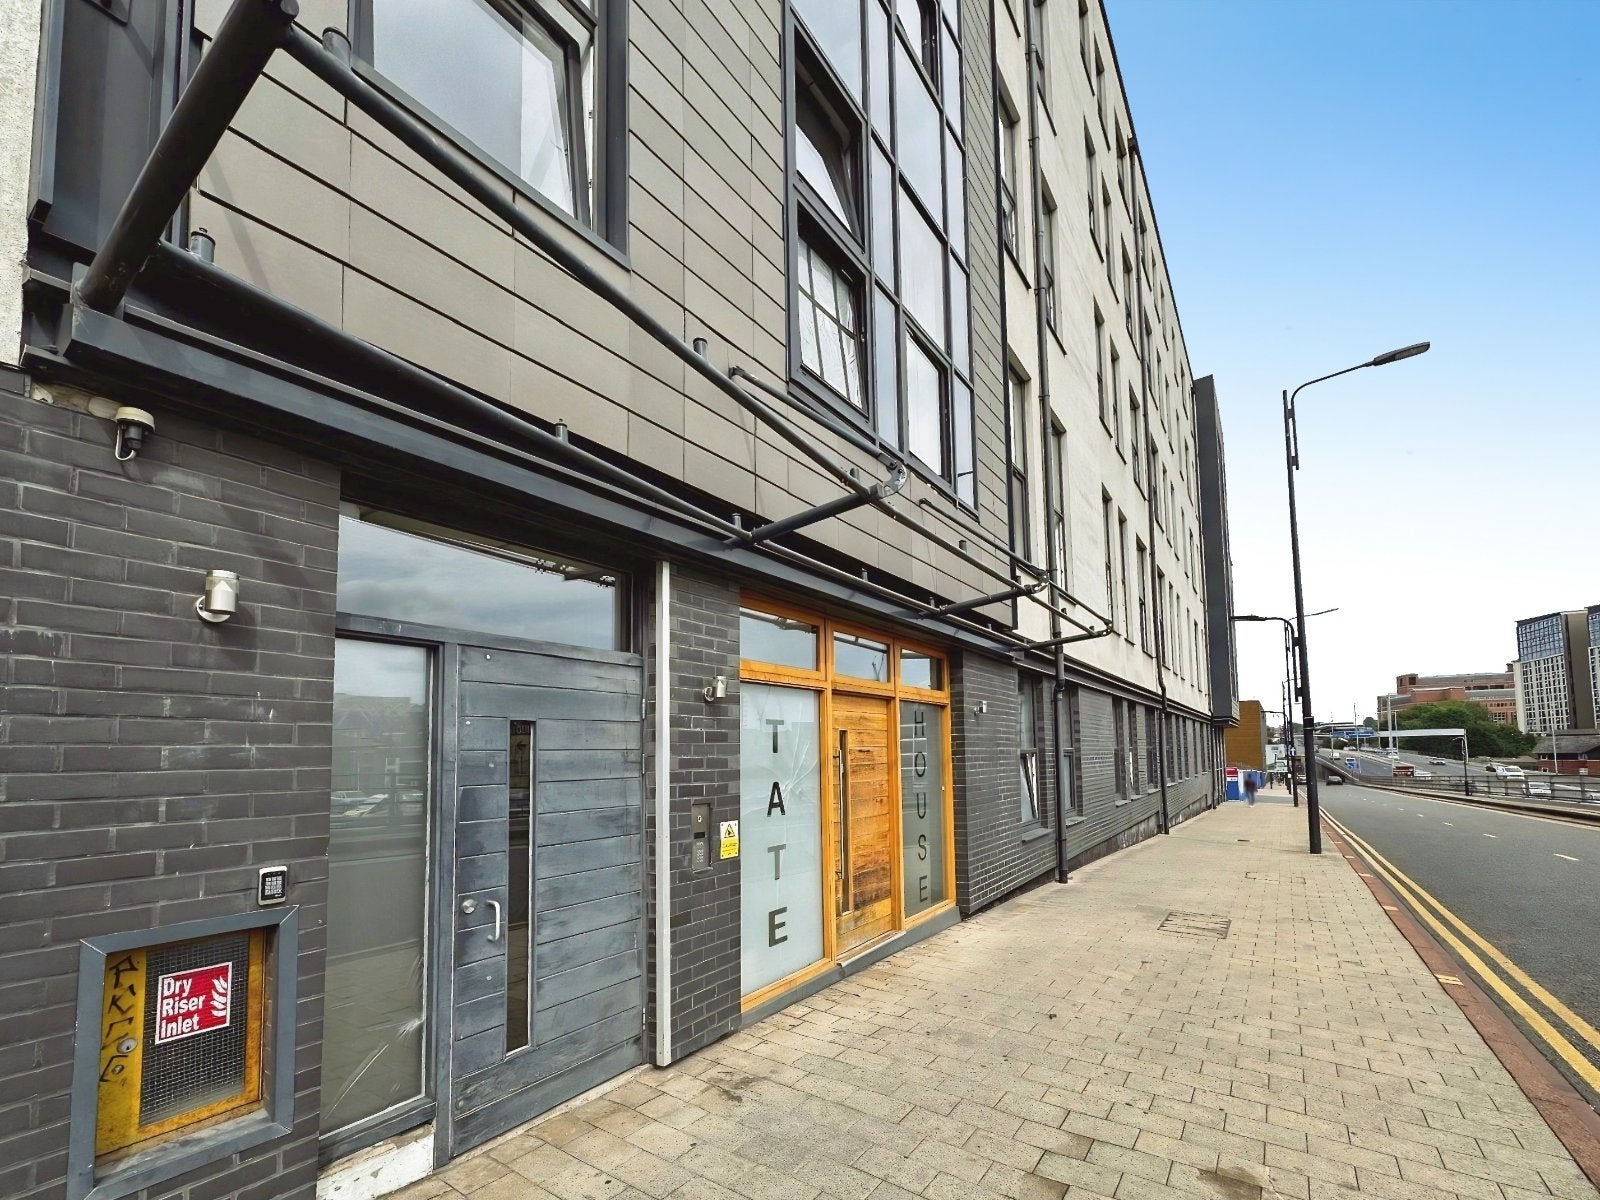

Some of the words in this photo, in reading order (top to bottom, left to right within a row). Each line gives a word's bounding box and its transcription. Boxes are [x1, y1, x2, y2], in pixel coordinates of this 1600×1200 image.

[914, 710, 928, 903] HOUSE
[765, 719, 788, 947] TATE
[163, 977, 192, 997] Dry
[162, 995, 206, 1018] Riser
[160, 1013, 199, 1039] Inlet
